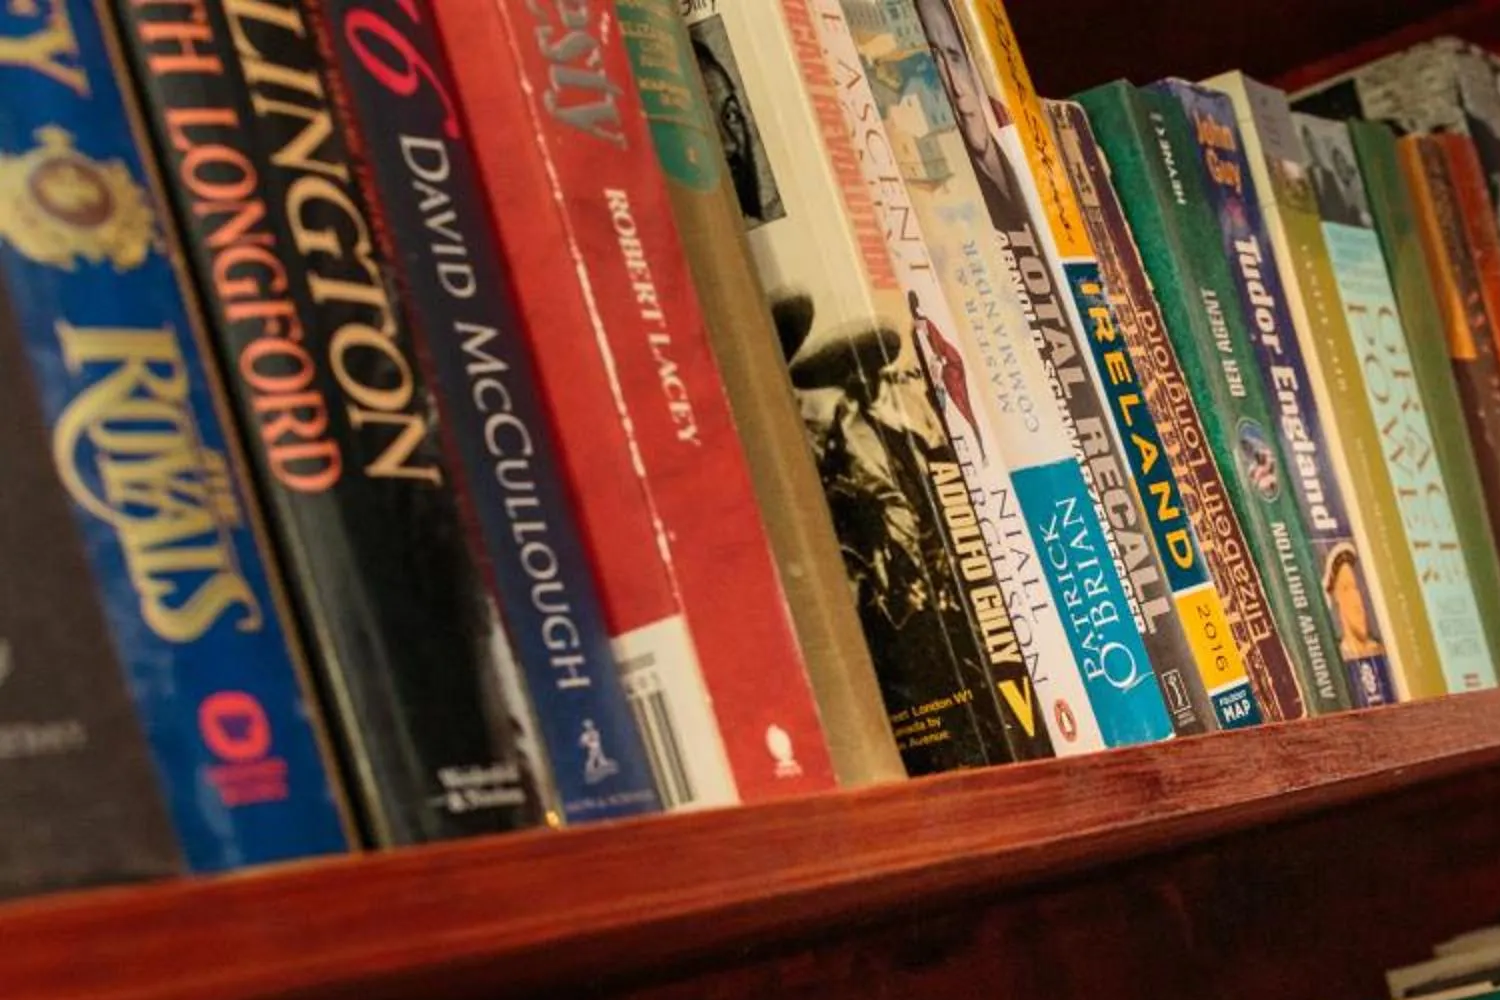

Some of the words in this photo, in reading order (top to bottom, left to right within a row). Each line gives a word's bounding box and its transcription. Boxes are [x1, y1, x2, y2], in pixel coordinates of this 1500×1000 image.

[165, 107, 342, 493] LONGFORD
[604, 187, 664, 323] ROBERT
[648, 331, 701, 447] LACEY
[962, 240, 1041, 435] COMMANDER
[965, 298, 1012, 415] MASTER
[1200, 287, 1233, 354] AGENT
[1223, 358, 1247, 398] DER
[399, 133, 477, 299] DAVID
[454, 321, 591, 690] MCCULLOUGH
[1012, 220, 1080, 400] TOTAL
[1082, 425, 1172, 636] RECALL
[1078, 280, 1194, 571] IRELAND
[1136, 306, 1209, 468] Longford
[1233, 234, 1282, 355] Tudor
[1269, 363, 1338, 532] England
[929, 460, 995, 582] ADOLFO
[970, 583, 1024, 666] GILLY
[990, 486, 1049, 624] NIALL
[1039, 518, 1104, 682] PATRICK
[1055, 496, 1154, 694] O'BRIAN
[1202, 479, 1274, 642] Elizabeth
[1269, 521, 1309, 609] BRITTON
[1195, 604, 1228, 673] 2016
[1222, 698, 1252, 724] MAP
[1300, 610, 1336, 699] ANDREW
